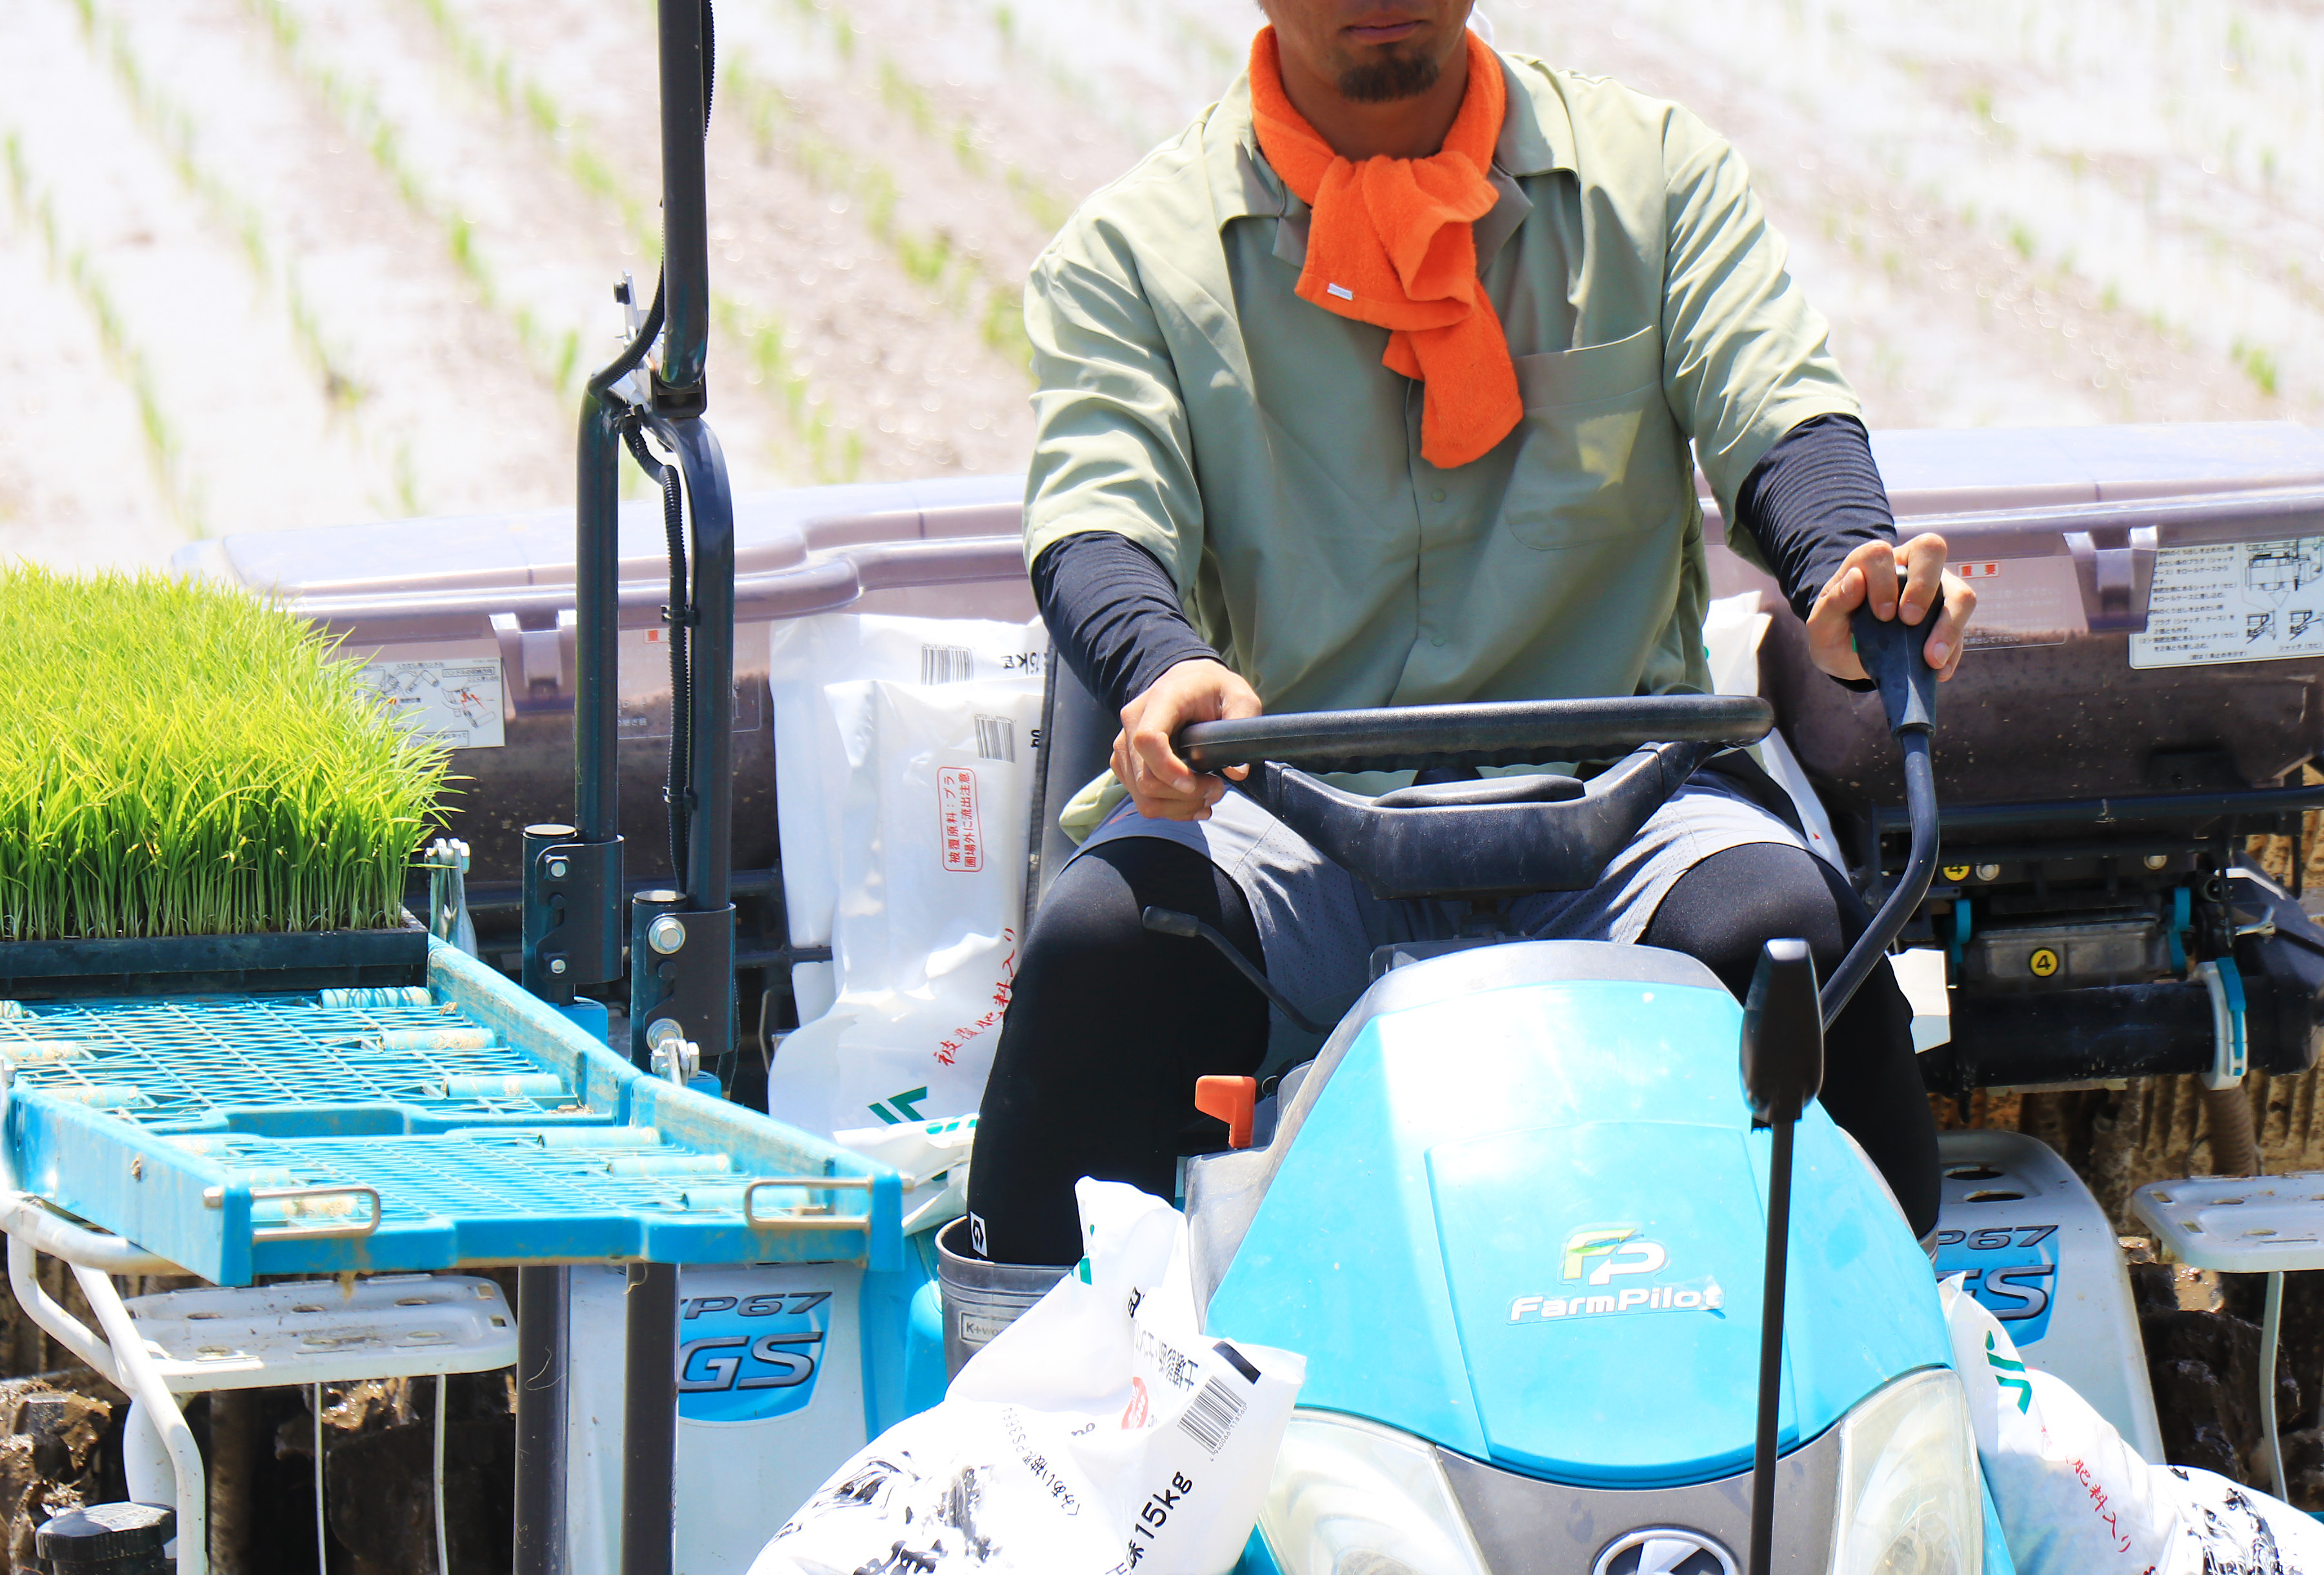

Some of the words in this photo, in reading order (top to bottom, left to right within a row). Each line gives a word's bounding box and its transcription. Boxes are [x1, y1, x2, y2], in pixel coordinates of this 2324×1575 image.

[2036, 954, 2051, 970] 4
[679, 1291, 833, 1320] P67
[1510, 1286, 1722, 1321] FarmPilot
[1135, 1470, 1193, 1540] 15kg
